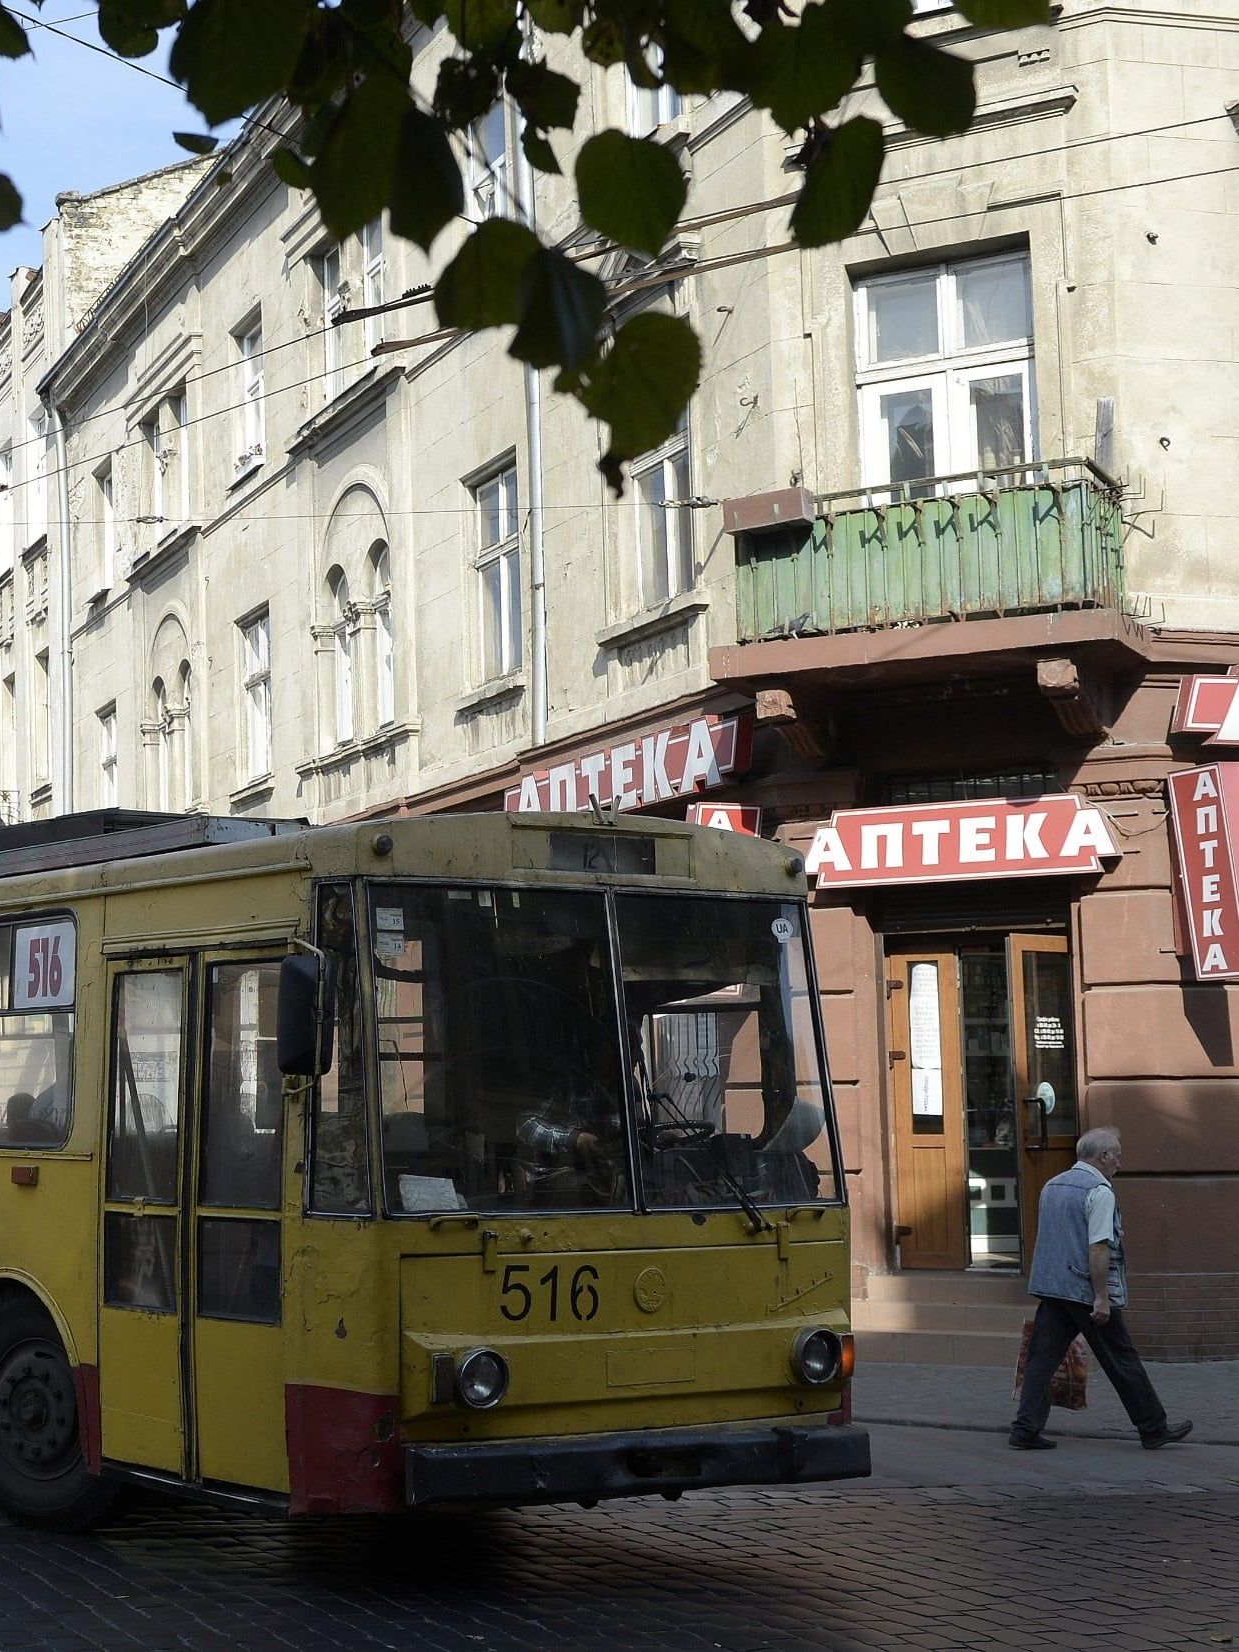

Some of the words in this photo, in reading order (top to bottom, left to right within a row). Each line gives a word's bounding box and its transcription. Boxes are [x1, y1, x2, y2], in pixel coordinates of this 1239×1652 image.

[518, 719, 721, 811] АПТЕКА
[804, 808, 1116, 874] АПТЕКА
[1192, 772, 1229, 972] АПТЕКА
[776, 923, 789, 934] UA
[27, 935, 63, 999] 516
[500, 1264, 600, 1322] 516
